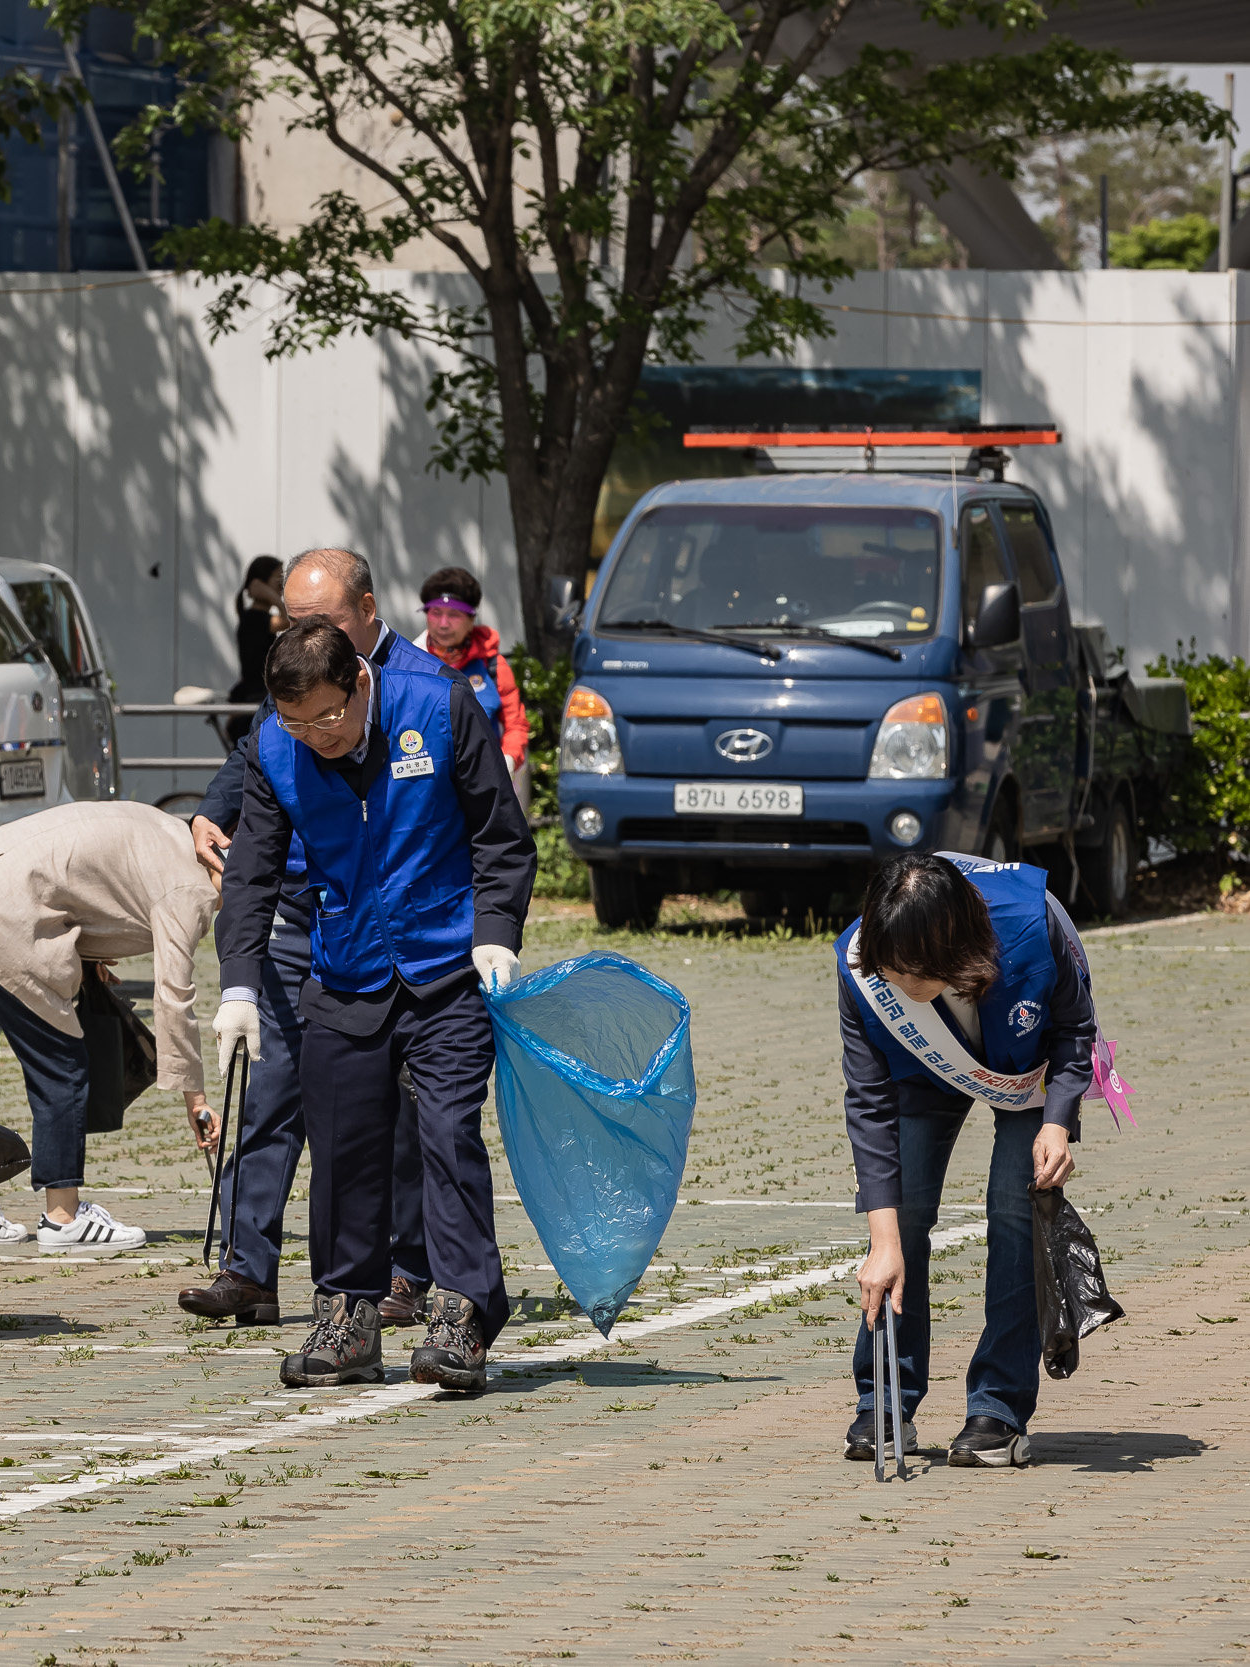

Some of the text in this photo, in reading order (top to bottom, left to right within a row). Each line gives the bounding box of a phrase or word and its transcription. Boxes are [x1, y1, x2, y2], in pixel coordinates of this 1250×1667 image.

[737, 790, 790, 810] 6598
[897, 1021, 930, 1050] 함께
[923, 1050, 957, 1073] 하는
